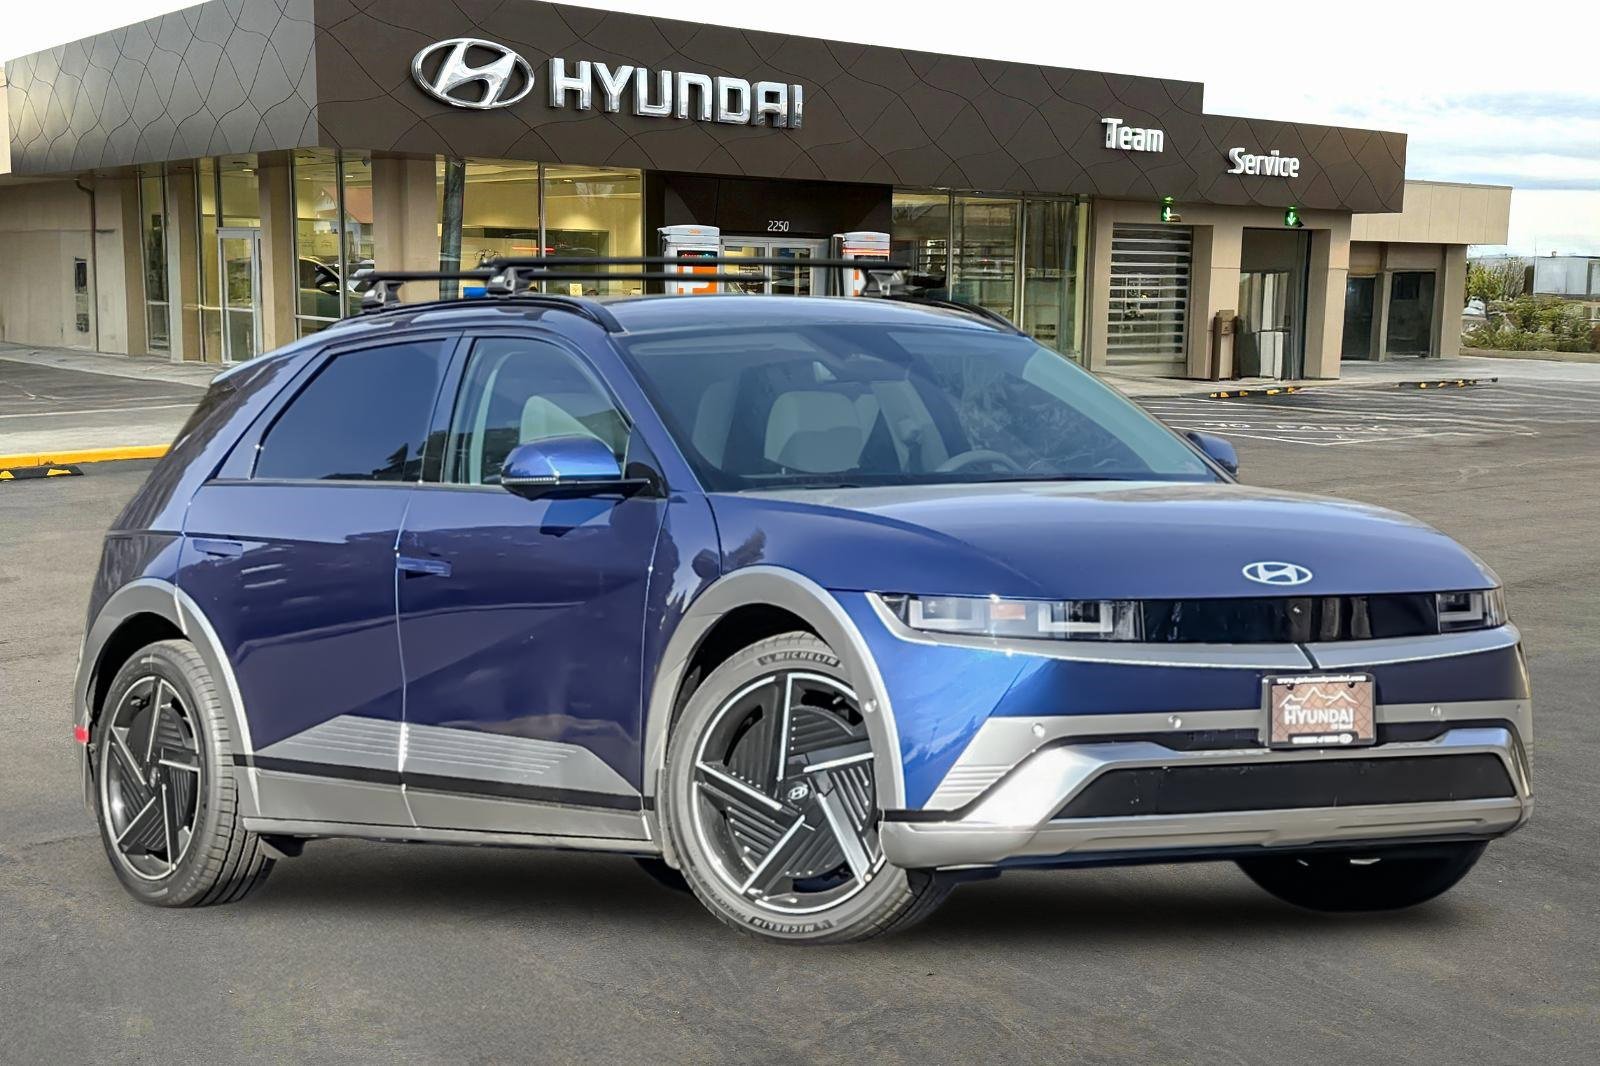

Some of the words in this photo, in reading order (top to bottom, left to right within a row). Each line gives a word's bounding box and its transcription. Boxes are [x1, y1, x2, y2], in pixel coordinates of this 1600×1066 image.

[549, 57, 803, 129] HYUNDAI
[1101, 117, 1164, 153] Team
[1227, 147, 1300, 178] Service
[767, 220, 790, 232] 2250
[774, 651, 837, 667] MICHELIN
[1284, 707, 1354, 725] HYUNDAI
[753, 918, 815, 934] MICHELIN
